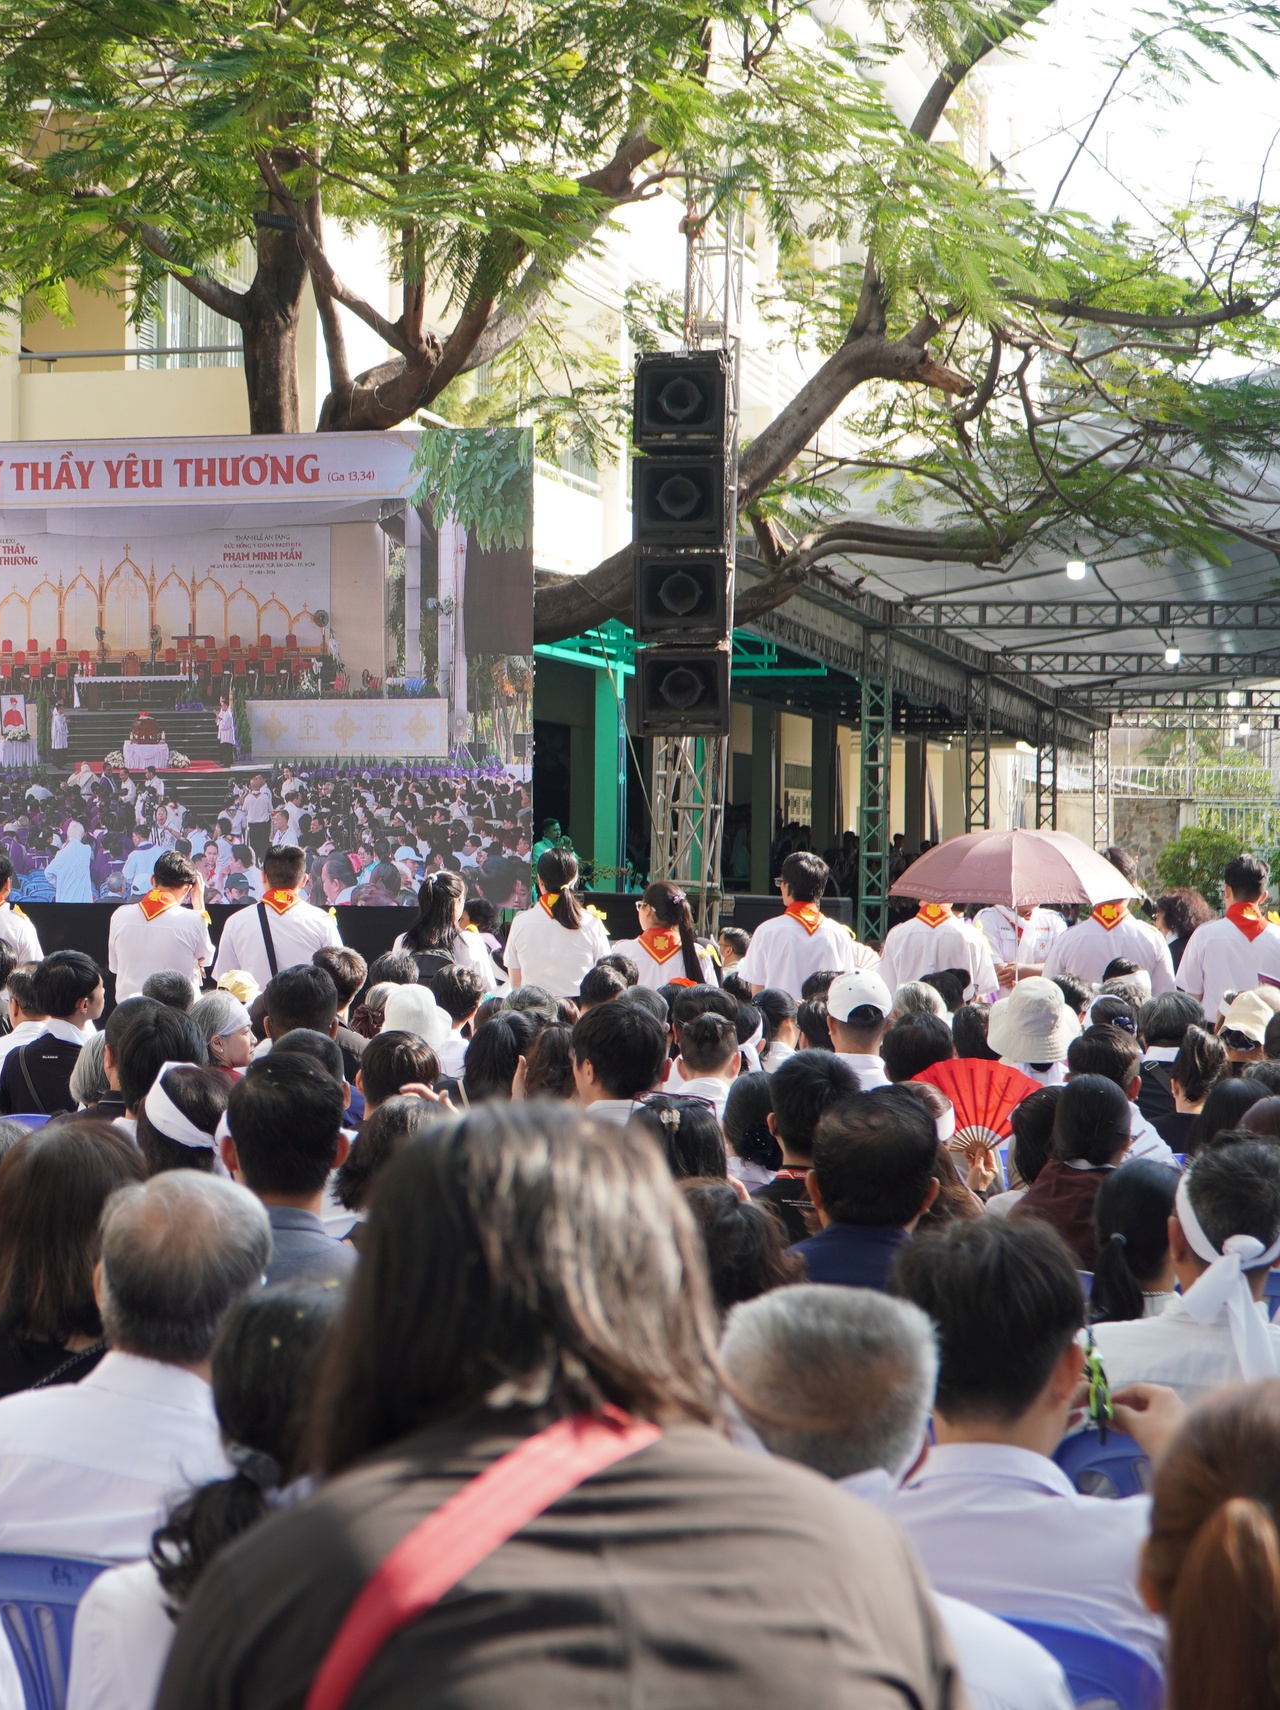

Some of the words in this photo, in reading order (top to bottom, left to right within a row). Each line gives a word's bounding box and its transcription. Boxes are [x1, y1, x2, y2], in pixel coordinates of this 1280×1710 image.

[10, 451, 95, 491] THẦY
[103, 453, 163, 489] YÊU
[173, 453, 320, 487] THƯƠNG
[327, 471, 345, 483] (Ga
[348, 470, 375, 482] 13,34)
[252, 551, 278, 561] MINH
